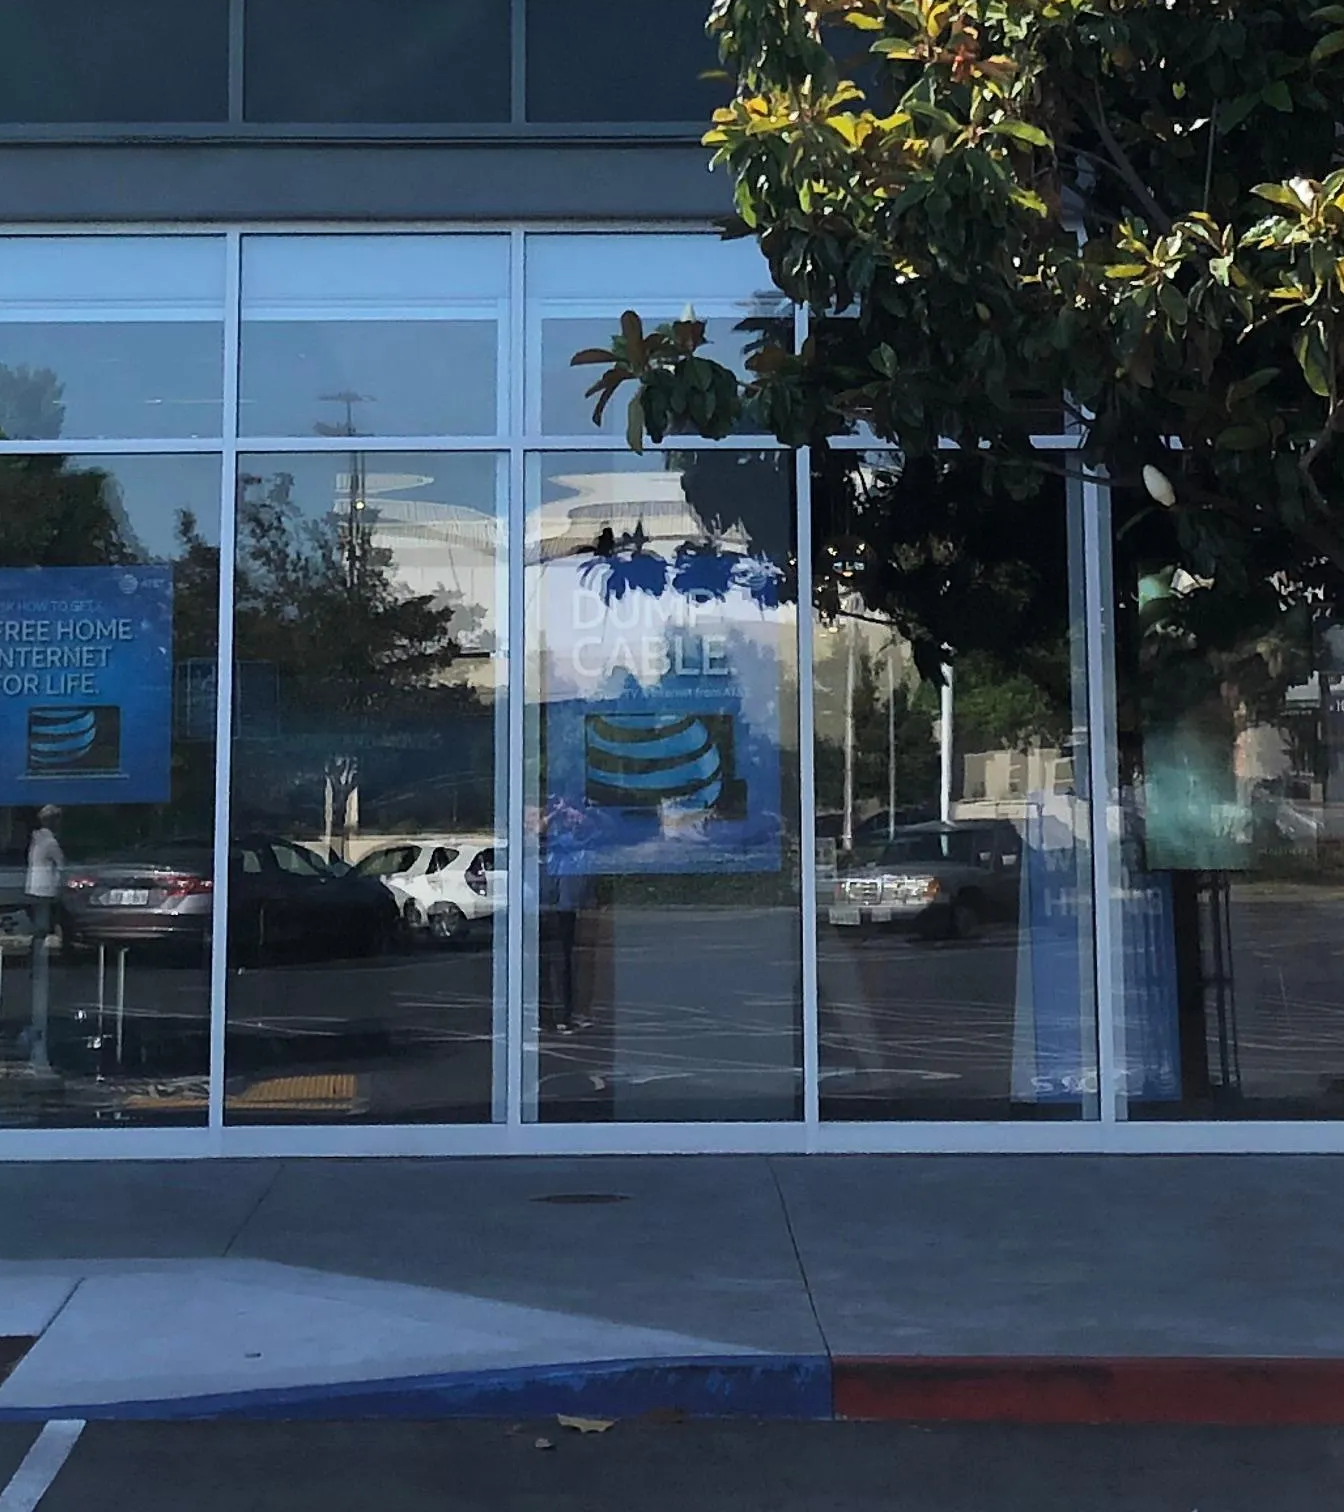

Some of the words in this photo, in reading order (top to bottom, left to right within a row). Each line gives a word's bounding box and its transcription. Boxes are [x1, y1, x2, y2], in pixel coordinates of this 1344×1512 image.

[572, 588, 720, 630] DUMP
[57, 618, 133, 641] HOME
[572, 635, 737, 678] CABLE.
[46, 673, 100, 696] LIFE.
